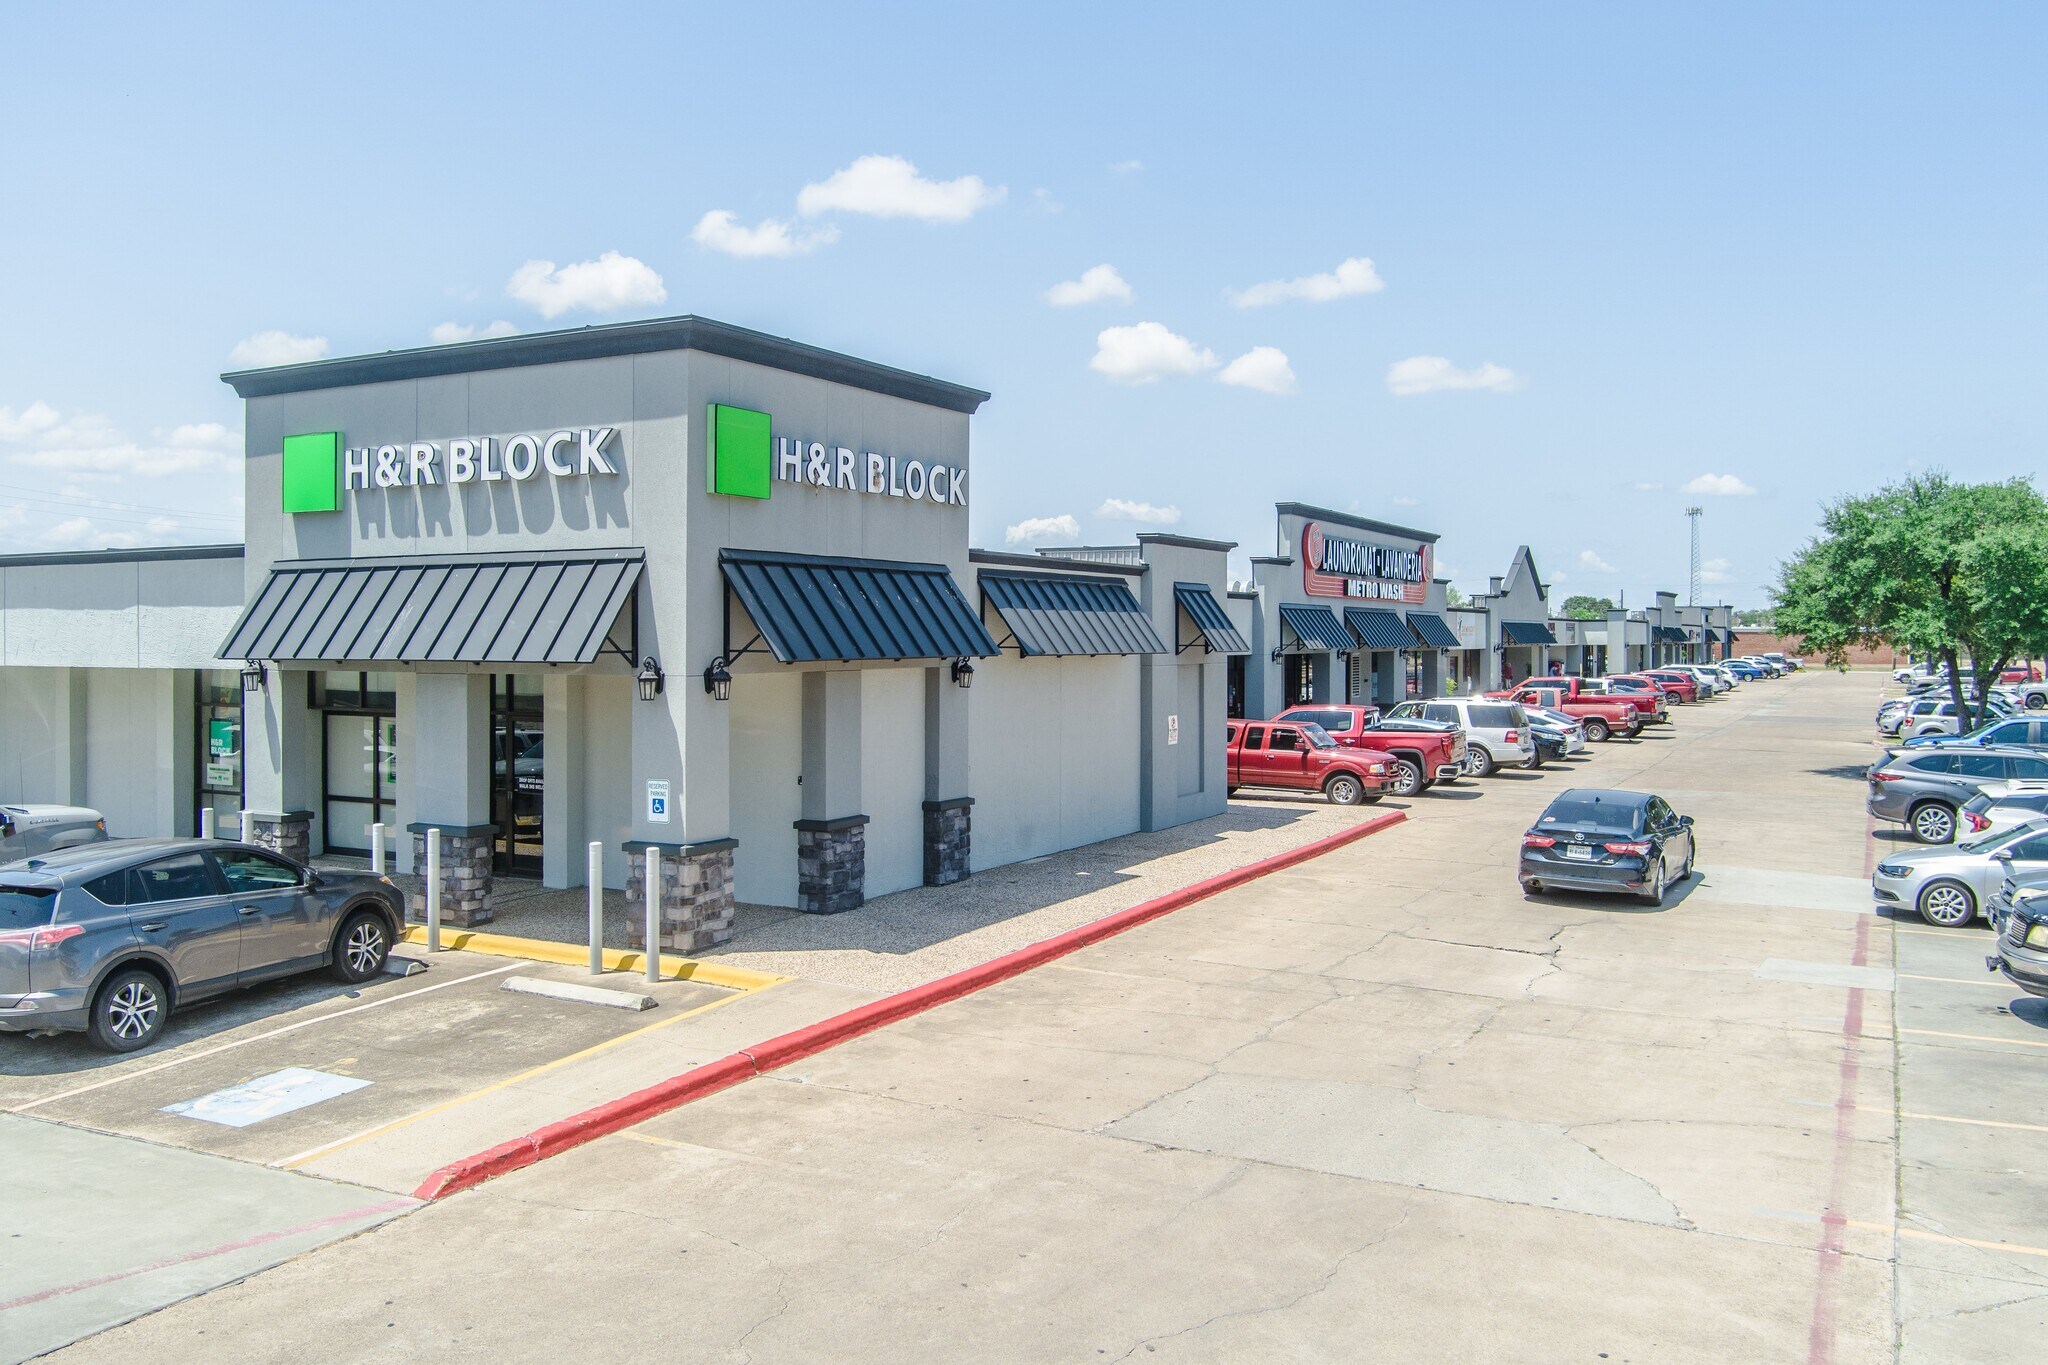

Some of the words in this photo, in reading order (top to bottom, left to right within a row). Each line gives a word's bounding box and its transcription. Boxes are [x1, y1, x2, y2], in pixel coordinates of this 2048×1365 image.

[345, 443, 443, 491] H&R
[449, 428, 619, 483] BLOCK
[776, 436, 857, 492] H&R
[865, 452, 967, 507] BLOCK
[1323, 539, 1377, 576] LAUNDROMAT
[1381, 549, 1422, 582] LAVANDERIA
[1347, 579, 1378, 599] METRO
[1379, 582, 1404, 600] WASH
[210, 738, 223, 746] H&R
